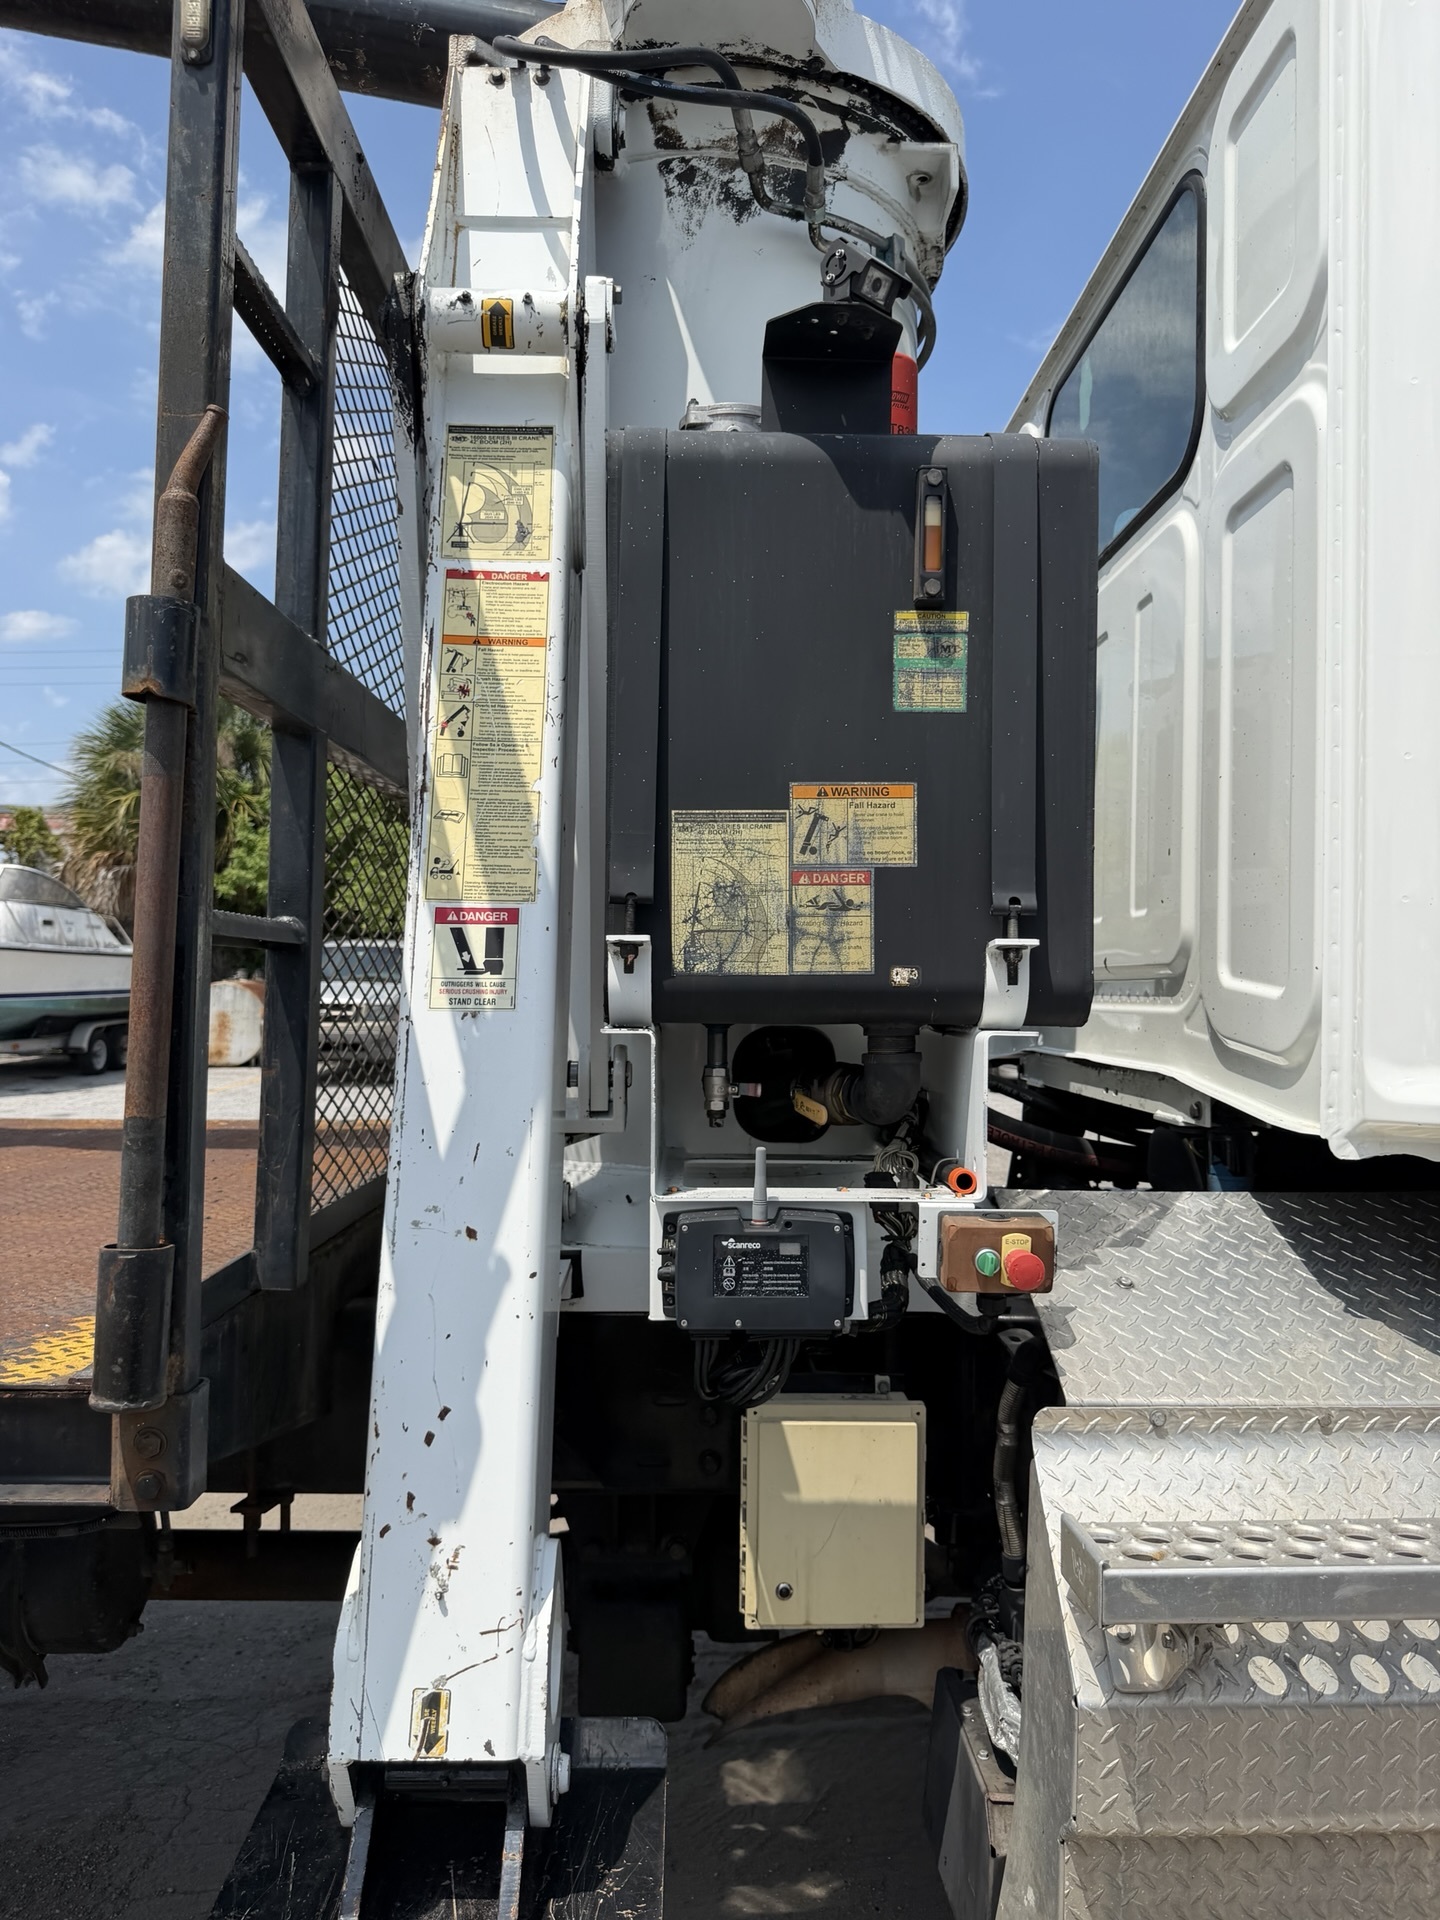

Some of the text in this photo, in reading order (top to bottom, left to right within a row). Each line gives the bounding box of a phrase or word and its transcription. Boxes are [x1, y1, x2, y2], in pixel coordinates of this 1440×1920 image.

[831, 787, 890, 796] WARNING
[813, 873, 865, 883] DANGER
[460, 911, 508, 921] DANGER
